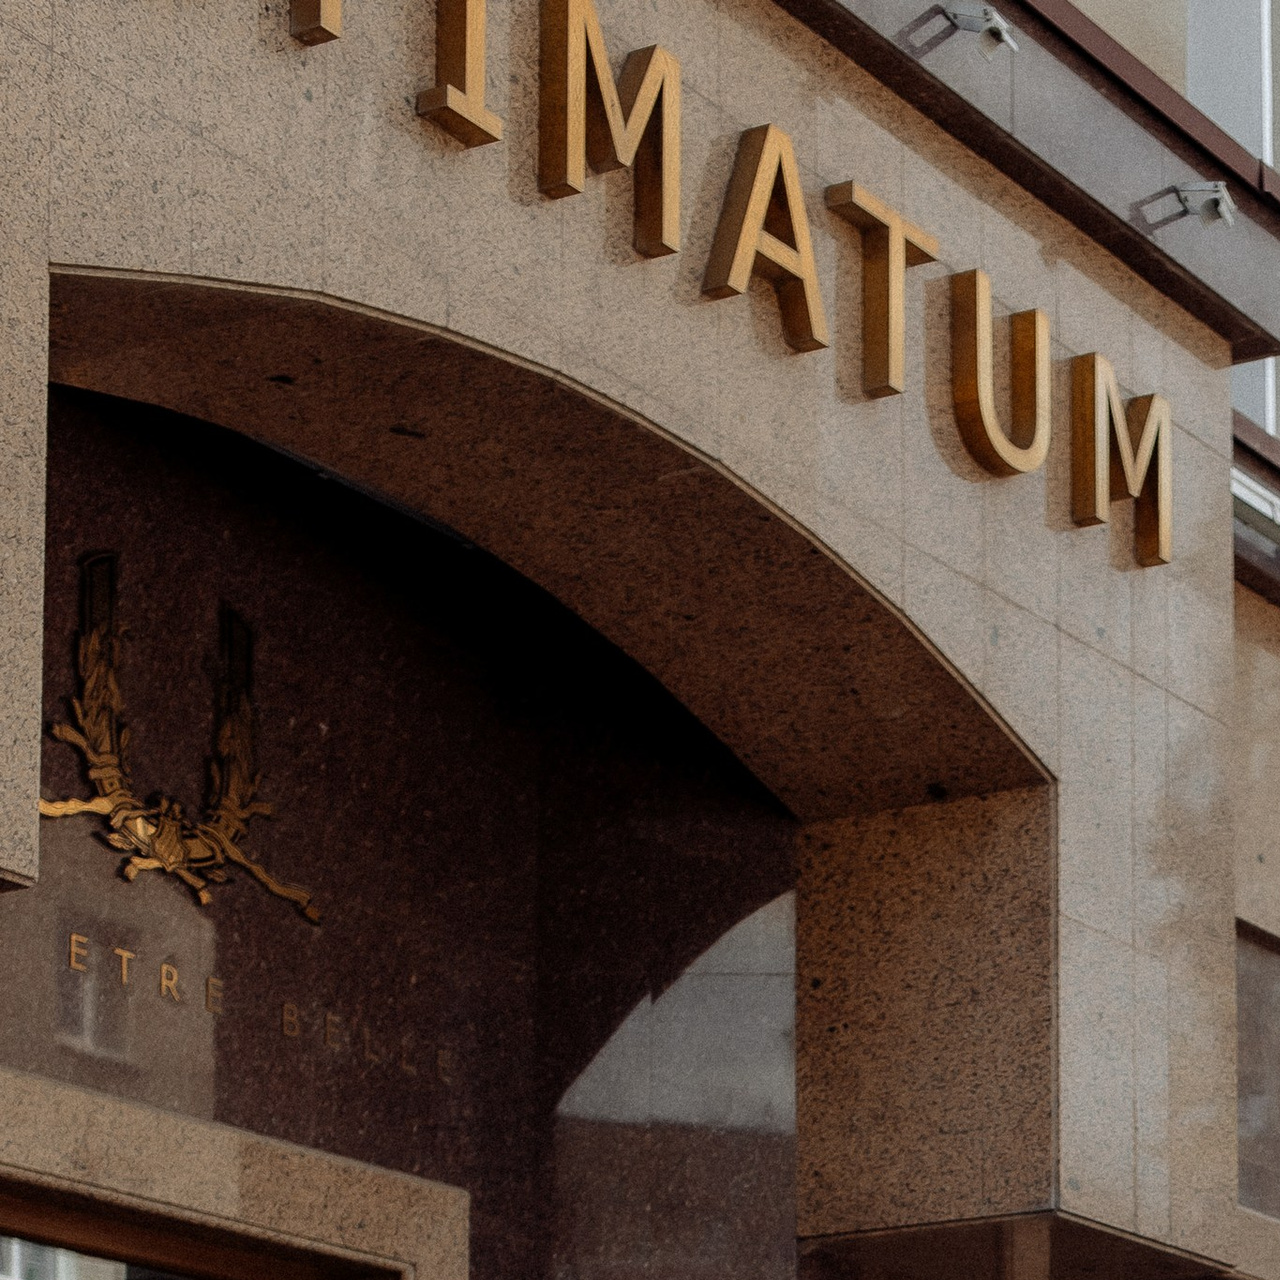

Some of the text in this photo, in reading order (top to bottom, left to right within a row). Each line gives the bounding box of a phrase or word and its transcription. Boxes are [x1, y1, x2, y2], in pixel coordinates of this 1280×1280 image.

[289, 0, 1172, 566] IMATUM
[69, 932, 461, 1086] ETRE BELLE
